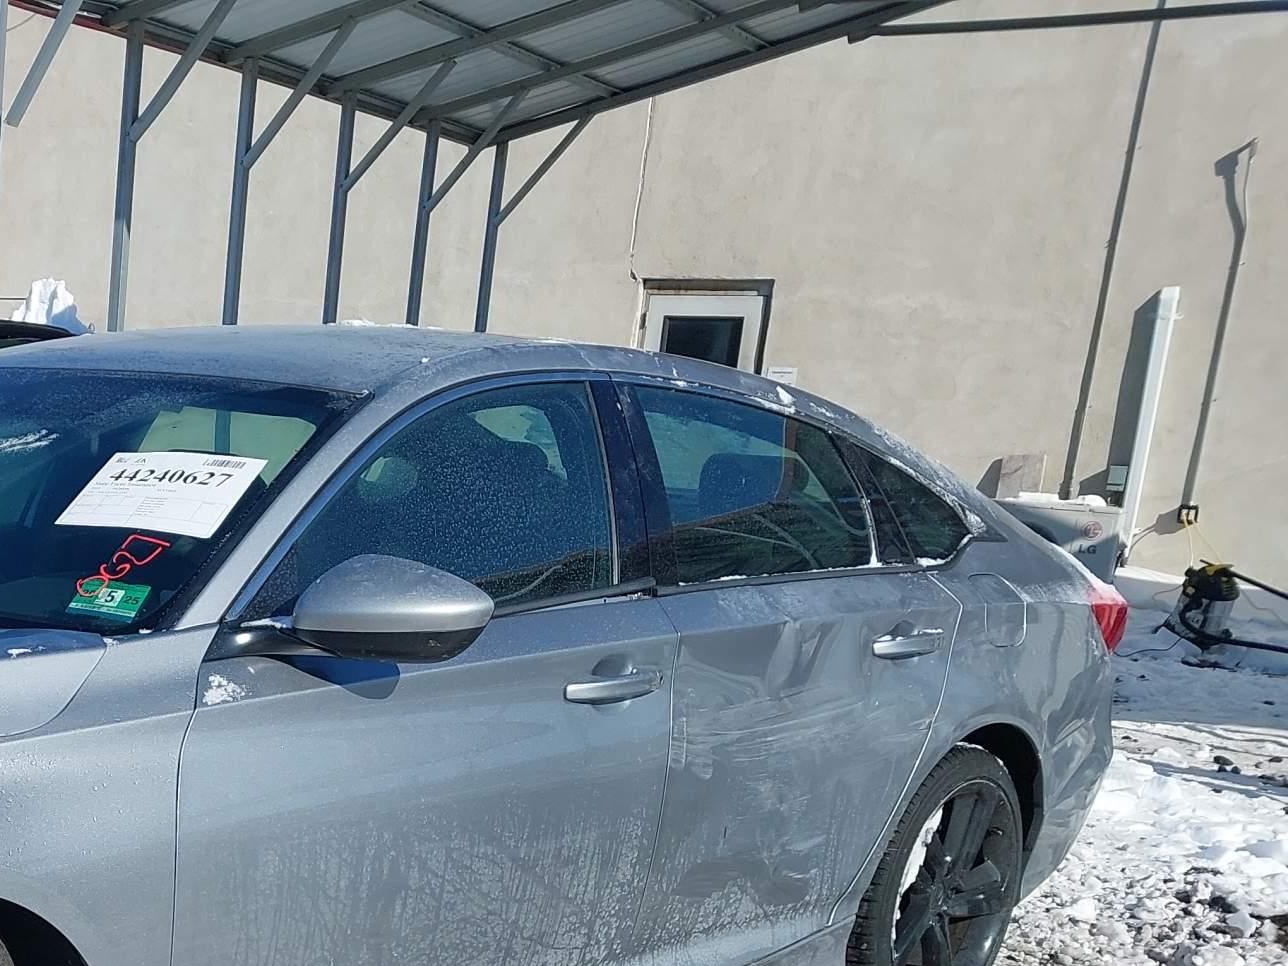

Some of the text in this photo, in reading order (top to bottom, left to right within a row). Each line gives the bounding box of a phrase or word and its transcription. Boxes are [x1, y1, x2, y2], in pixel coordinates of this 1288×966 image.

[109, 468, 234, 487] 44240627
[1078, 544, 1097, 554] LG
[104, 590, 118, 603] 5
[123, 595, 141, 606] 25
